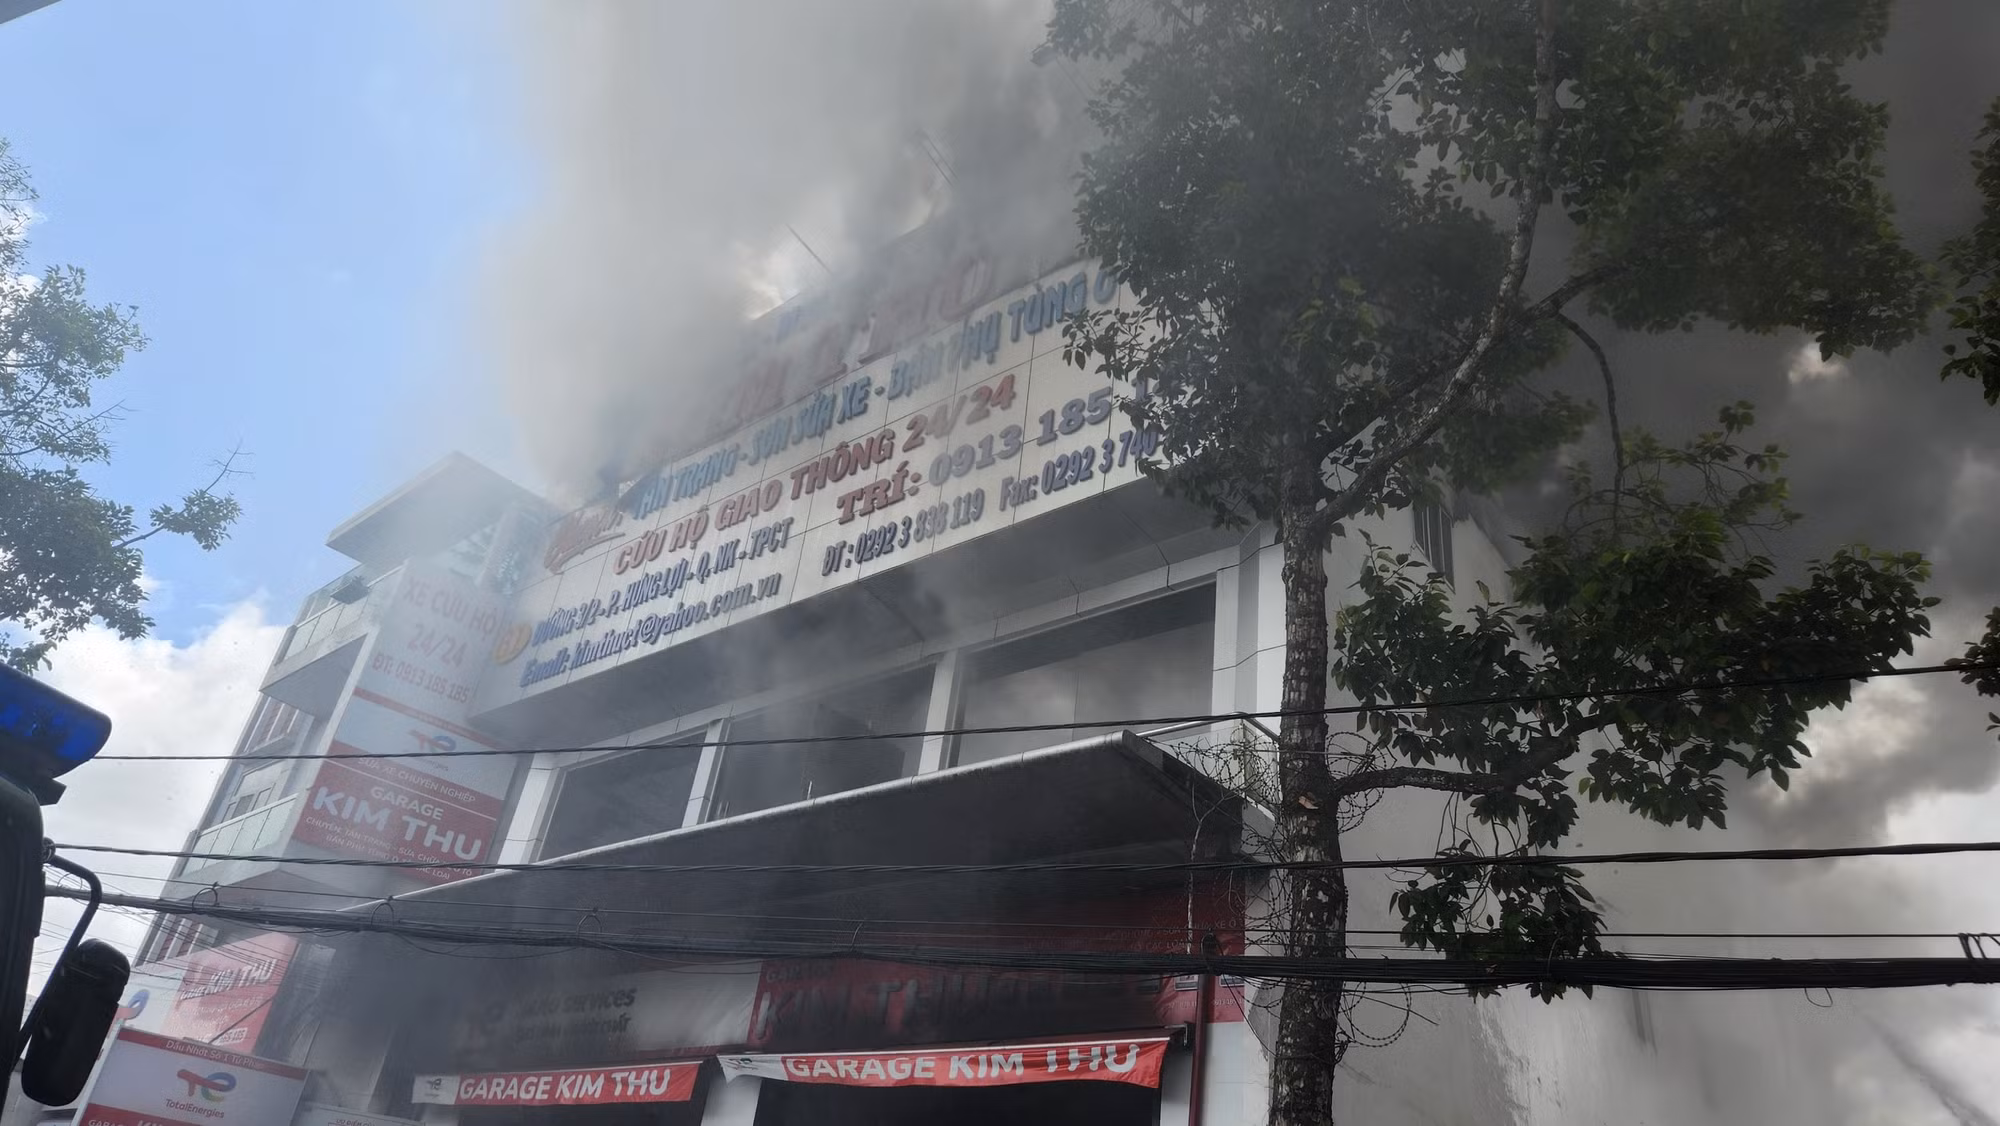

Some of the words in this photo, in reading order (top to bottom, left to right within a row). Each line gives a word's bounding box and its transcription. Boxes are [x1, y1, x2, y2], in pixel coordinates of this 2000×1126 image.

[837, 375, 872, 425] XE
[1007, 272, 1088, 343] TÙNG
[714, 479, 783, 532] GIAO
[790, 428, 896, 500] THÔNG
[902, 374, 1017, 453] 24/24
[929, 424, 1023, 487] 0913
[1036, 386, 1114, 447] 185
[855, 522, 897, 564] 0292
[898, 515, 912, 549] 3
[950, 488, 985, 530] 119
[1000, 474, 1040, 512] Fax:
[1040, 445, 1096, 496] 0292
[1099, 438, 1114, 474] 3
[748, 516, 795, 560] TPCT
[407, 622, 467, 668] 24/24
[312, 785, 393, 833] KIM
[402, 814, 483, 860] THU
[370, 786, 445, 821] GARAGE
[459, 1075, 553, 1101] GARAGE
[555, 1073, 606, 1099] KIM
[610, 1068, 672, 1097] THU
[786, 1056, 935, 1080] GARAGE
[949, 1053, 1024, 1079] KIM
[165, 1098, 226, 1119] TotalEnergies
